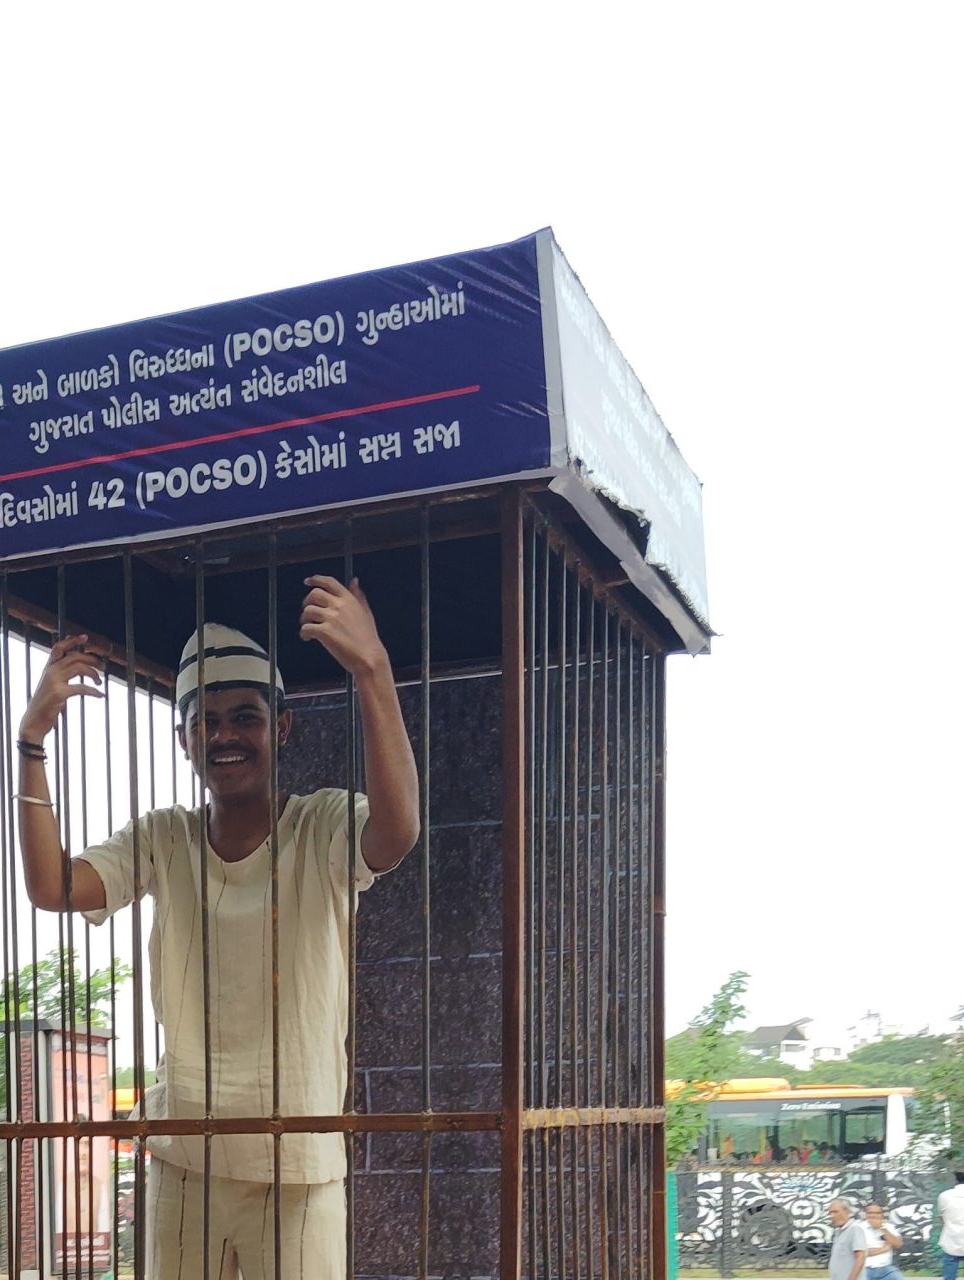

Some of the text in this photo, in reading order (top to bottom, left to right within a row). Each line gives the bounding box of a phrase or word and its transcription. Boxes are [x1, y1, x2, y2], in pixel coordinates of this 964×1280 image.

[12, 369, 48, 405] અને
[57, 354, 119, 398] બાળકો
[223, 311, 345, 368] (POCSO)
[355, 280, 466, 346] ગુન્હાઓમાં
[28, 353, 347, 454] ગુજરાત પોલીસ અત્યંત સંવેદનશીલ
[87, 477, 126, 512] 42
[135, 449, 268, 510] (POCSO)
[274, 430, 347, 479] કેસોમાં
[412, 420, 461, 455] સજા
